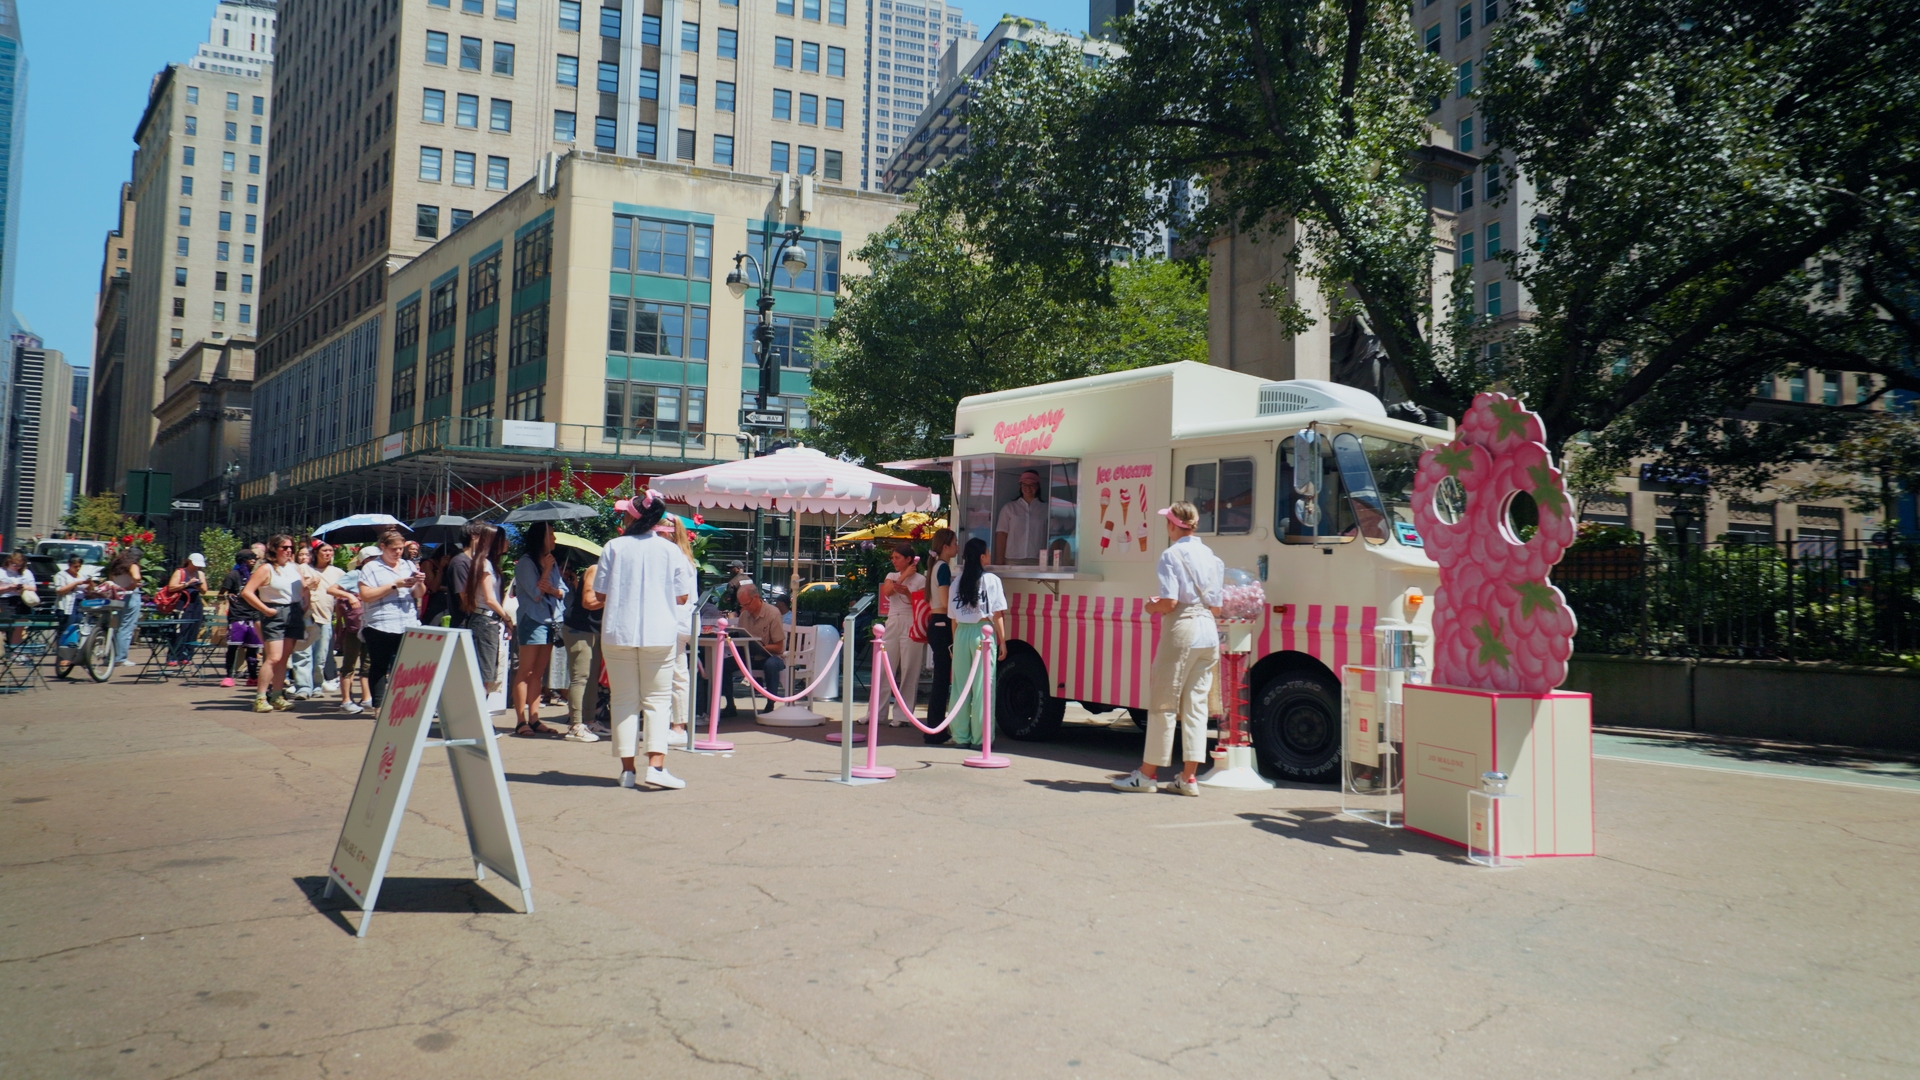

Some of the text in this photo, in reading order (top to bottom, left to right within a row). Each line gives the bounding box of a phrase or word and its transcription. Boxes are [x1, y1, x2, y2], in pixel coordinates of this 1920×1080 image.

[994, 408, 1065, 444] Raspberry
[1096, 465, 1153, 485] Ice cream
[392, 661, 438, 696] Raspberry
[388, 690, 421, 727] Ripple
[1428, 754, 1464, 768] JO MALONE
